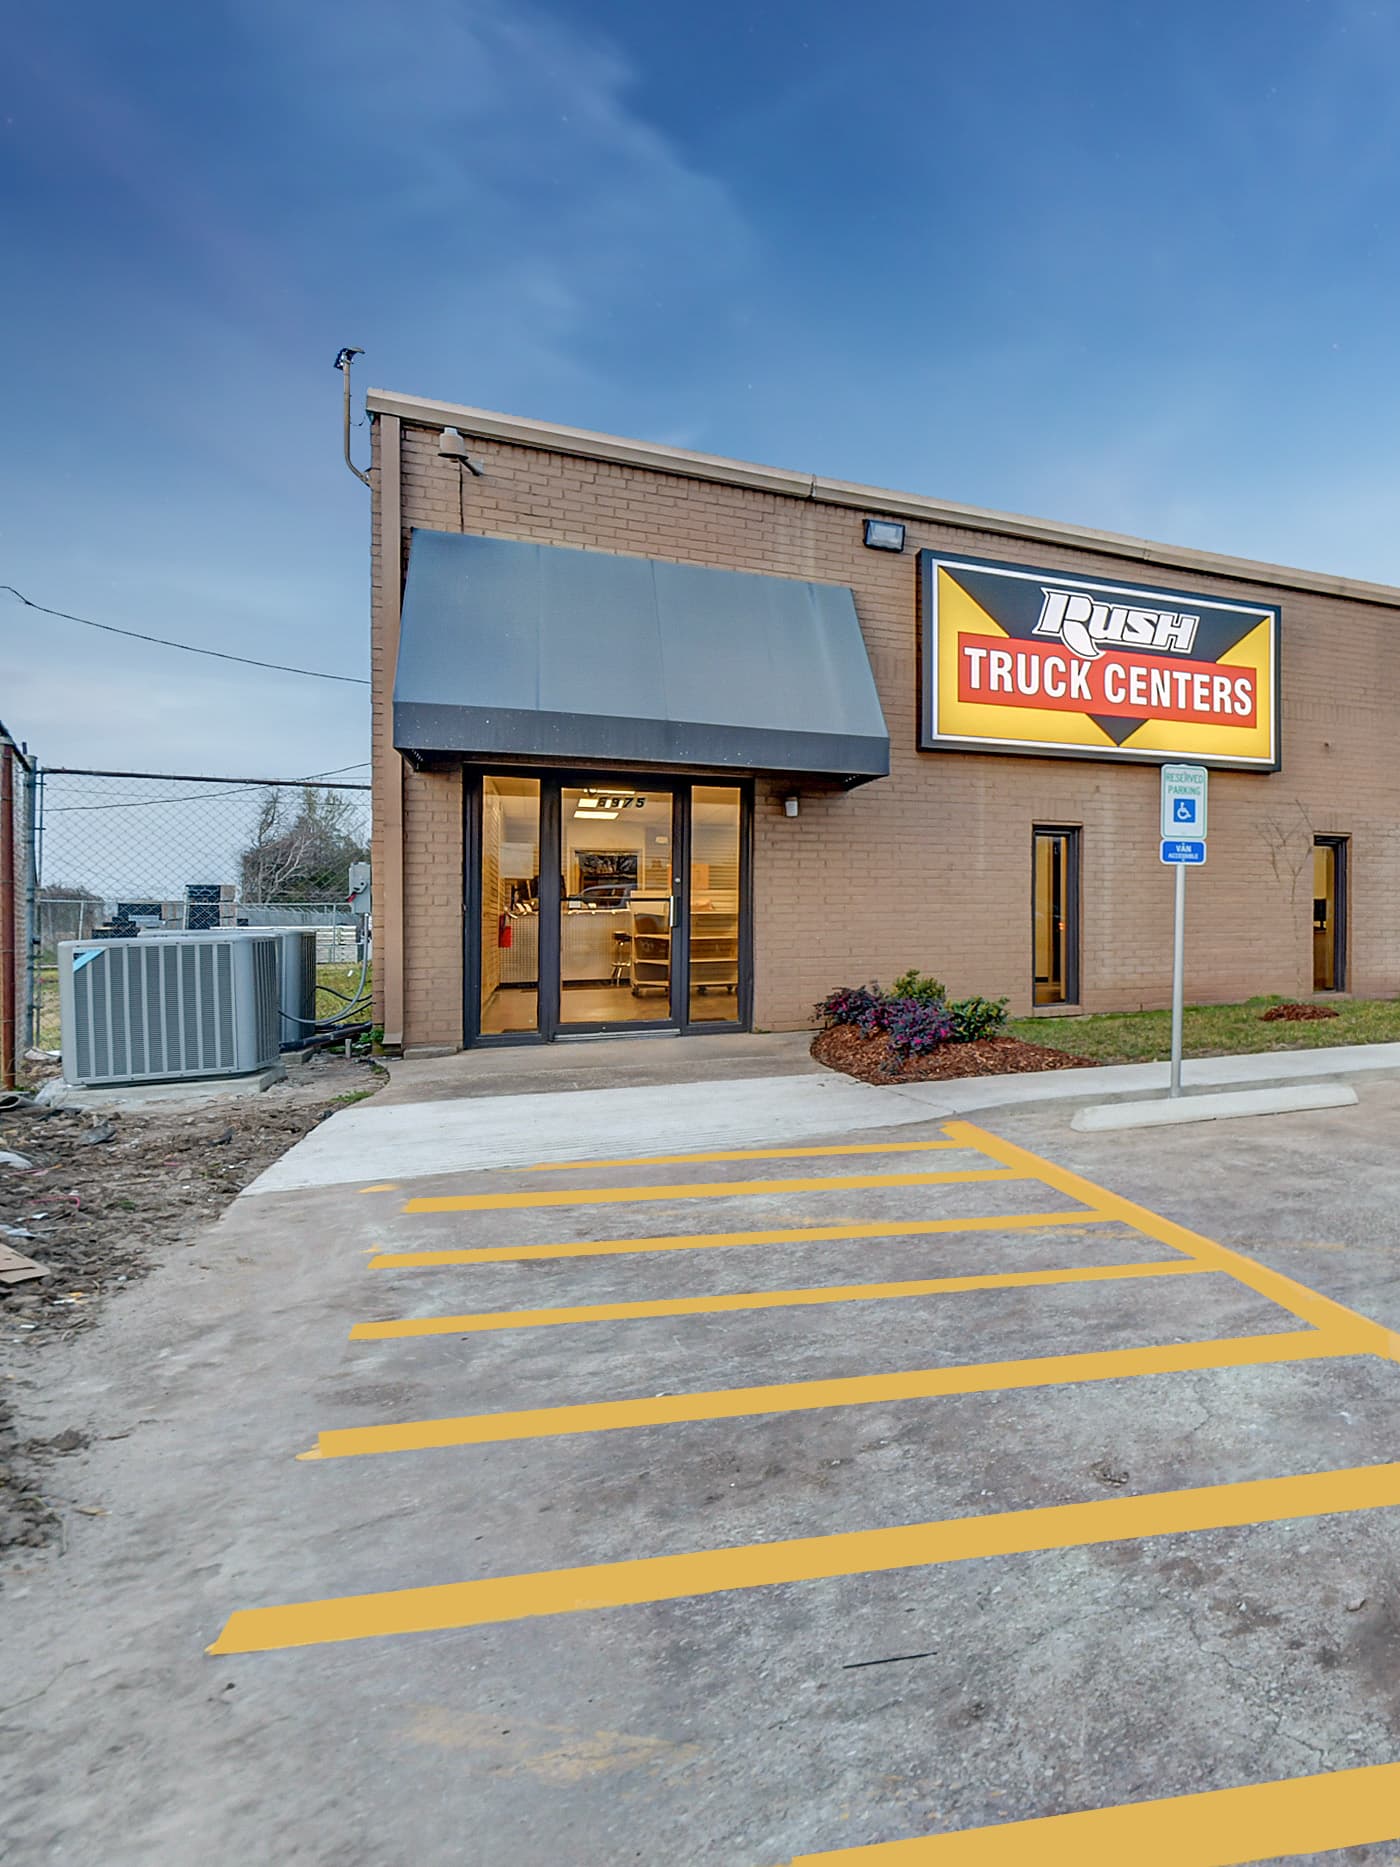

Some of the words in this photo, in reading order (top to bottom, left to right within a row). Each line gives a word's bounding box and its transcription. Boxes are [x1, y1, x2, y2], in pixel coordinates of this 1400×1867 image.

[1032, 587, 1200, 660] RUSH
[963, 646, 1092, 700] TRUCK
[1104, 662, 1252, 716] CENTERS
[1166, 773, 1203, 784] RESERVED
[1168, 785, 1201, 795] PARKING
[1175, 844, 1192, 852] VAN
